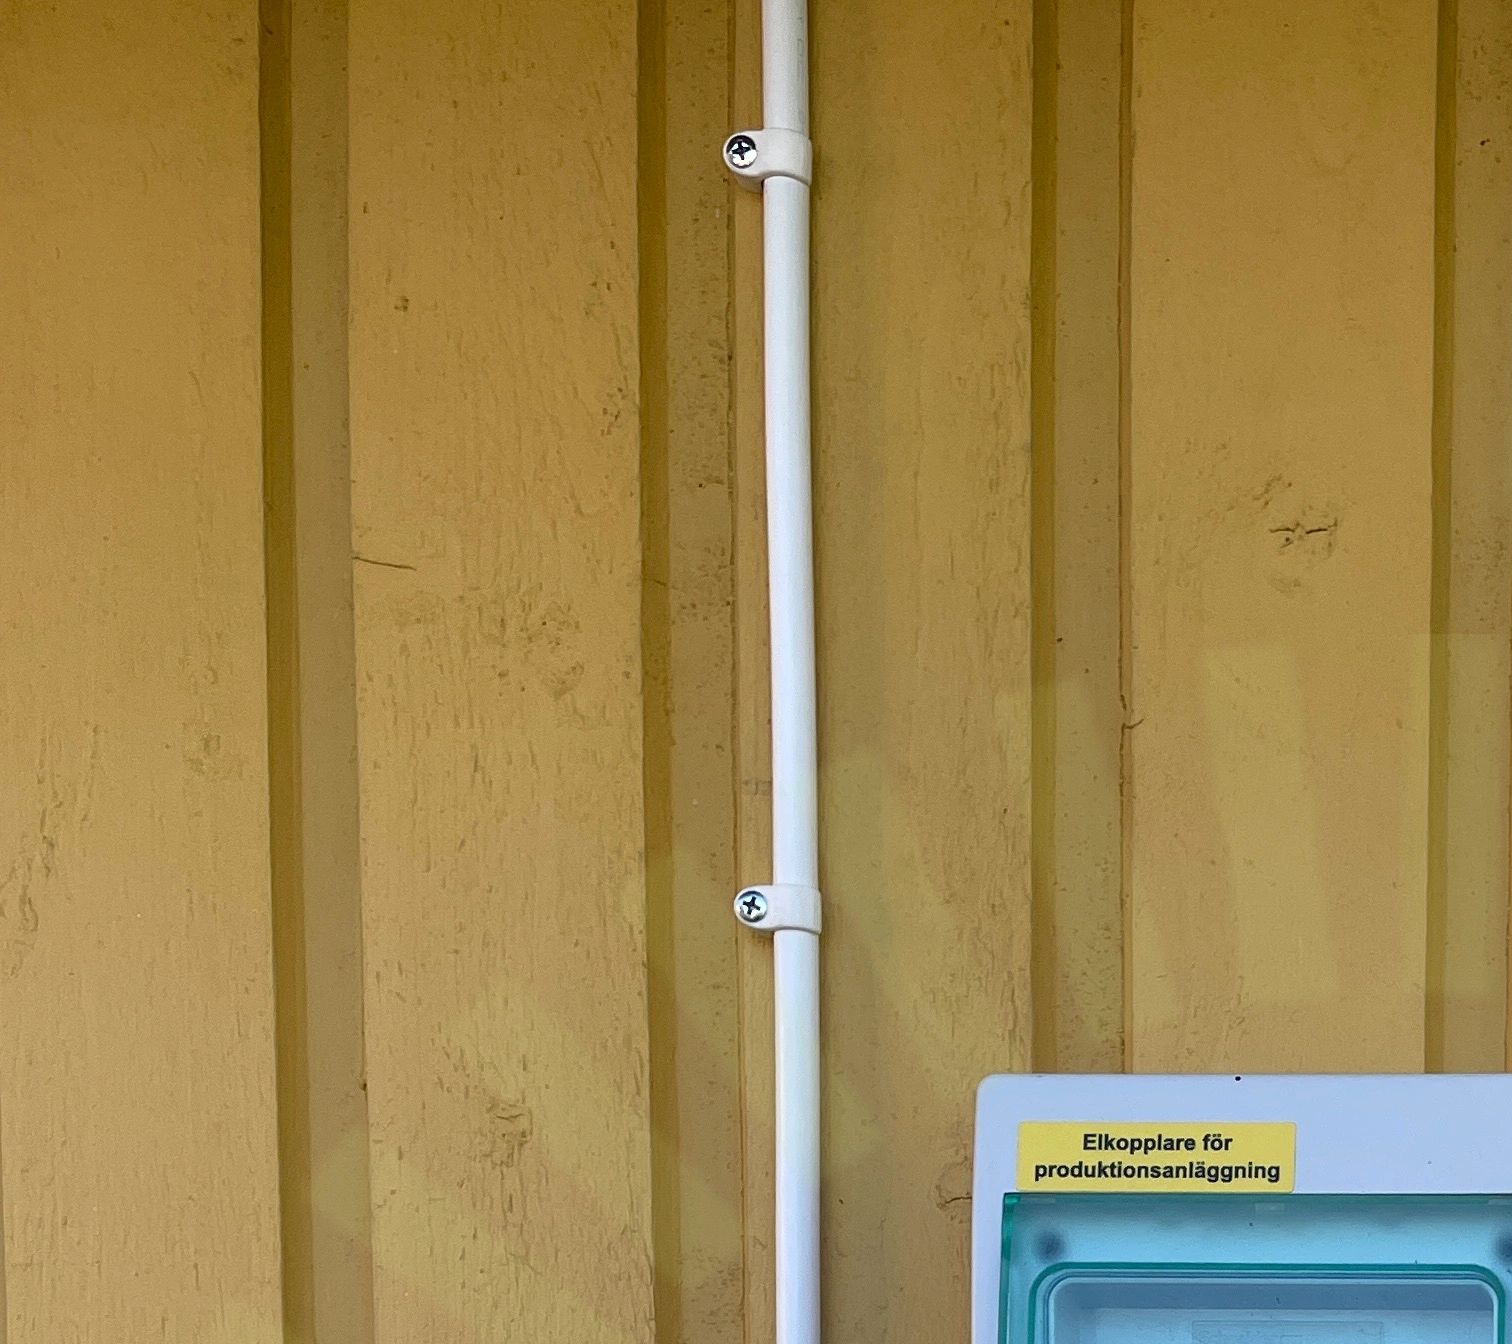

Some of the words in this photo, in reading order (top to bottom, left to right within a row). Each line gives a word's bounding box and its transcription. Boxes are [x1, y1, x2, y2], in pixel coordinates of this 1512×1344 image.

[1083, 1133, 1196, 1155] Elkopplare
[1203, 1133, 1233, 1151] för
[1034, 1161, 1281, 1183] produktionsanläggning
